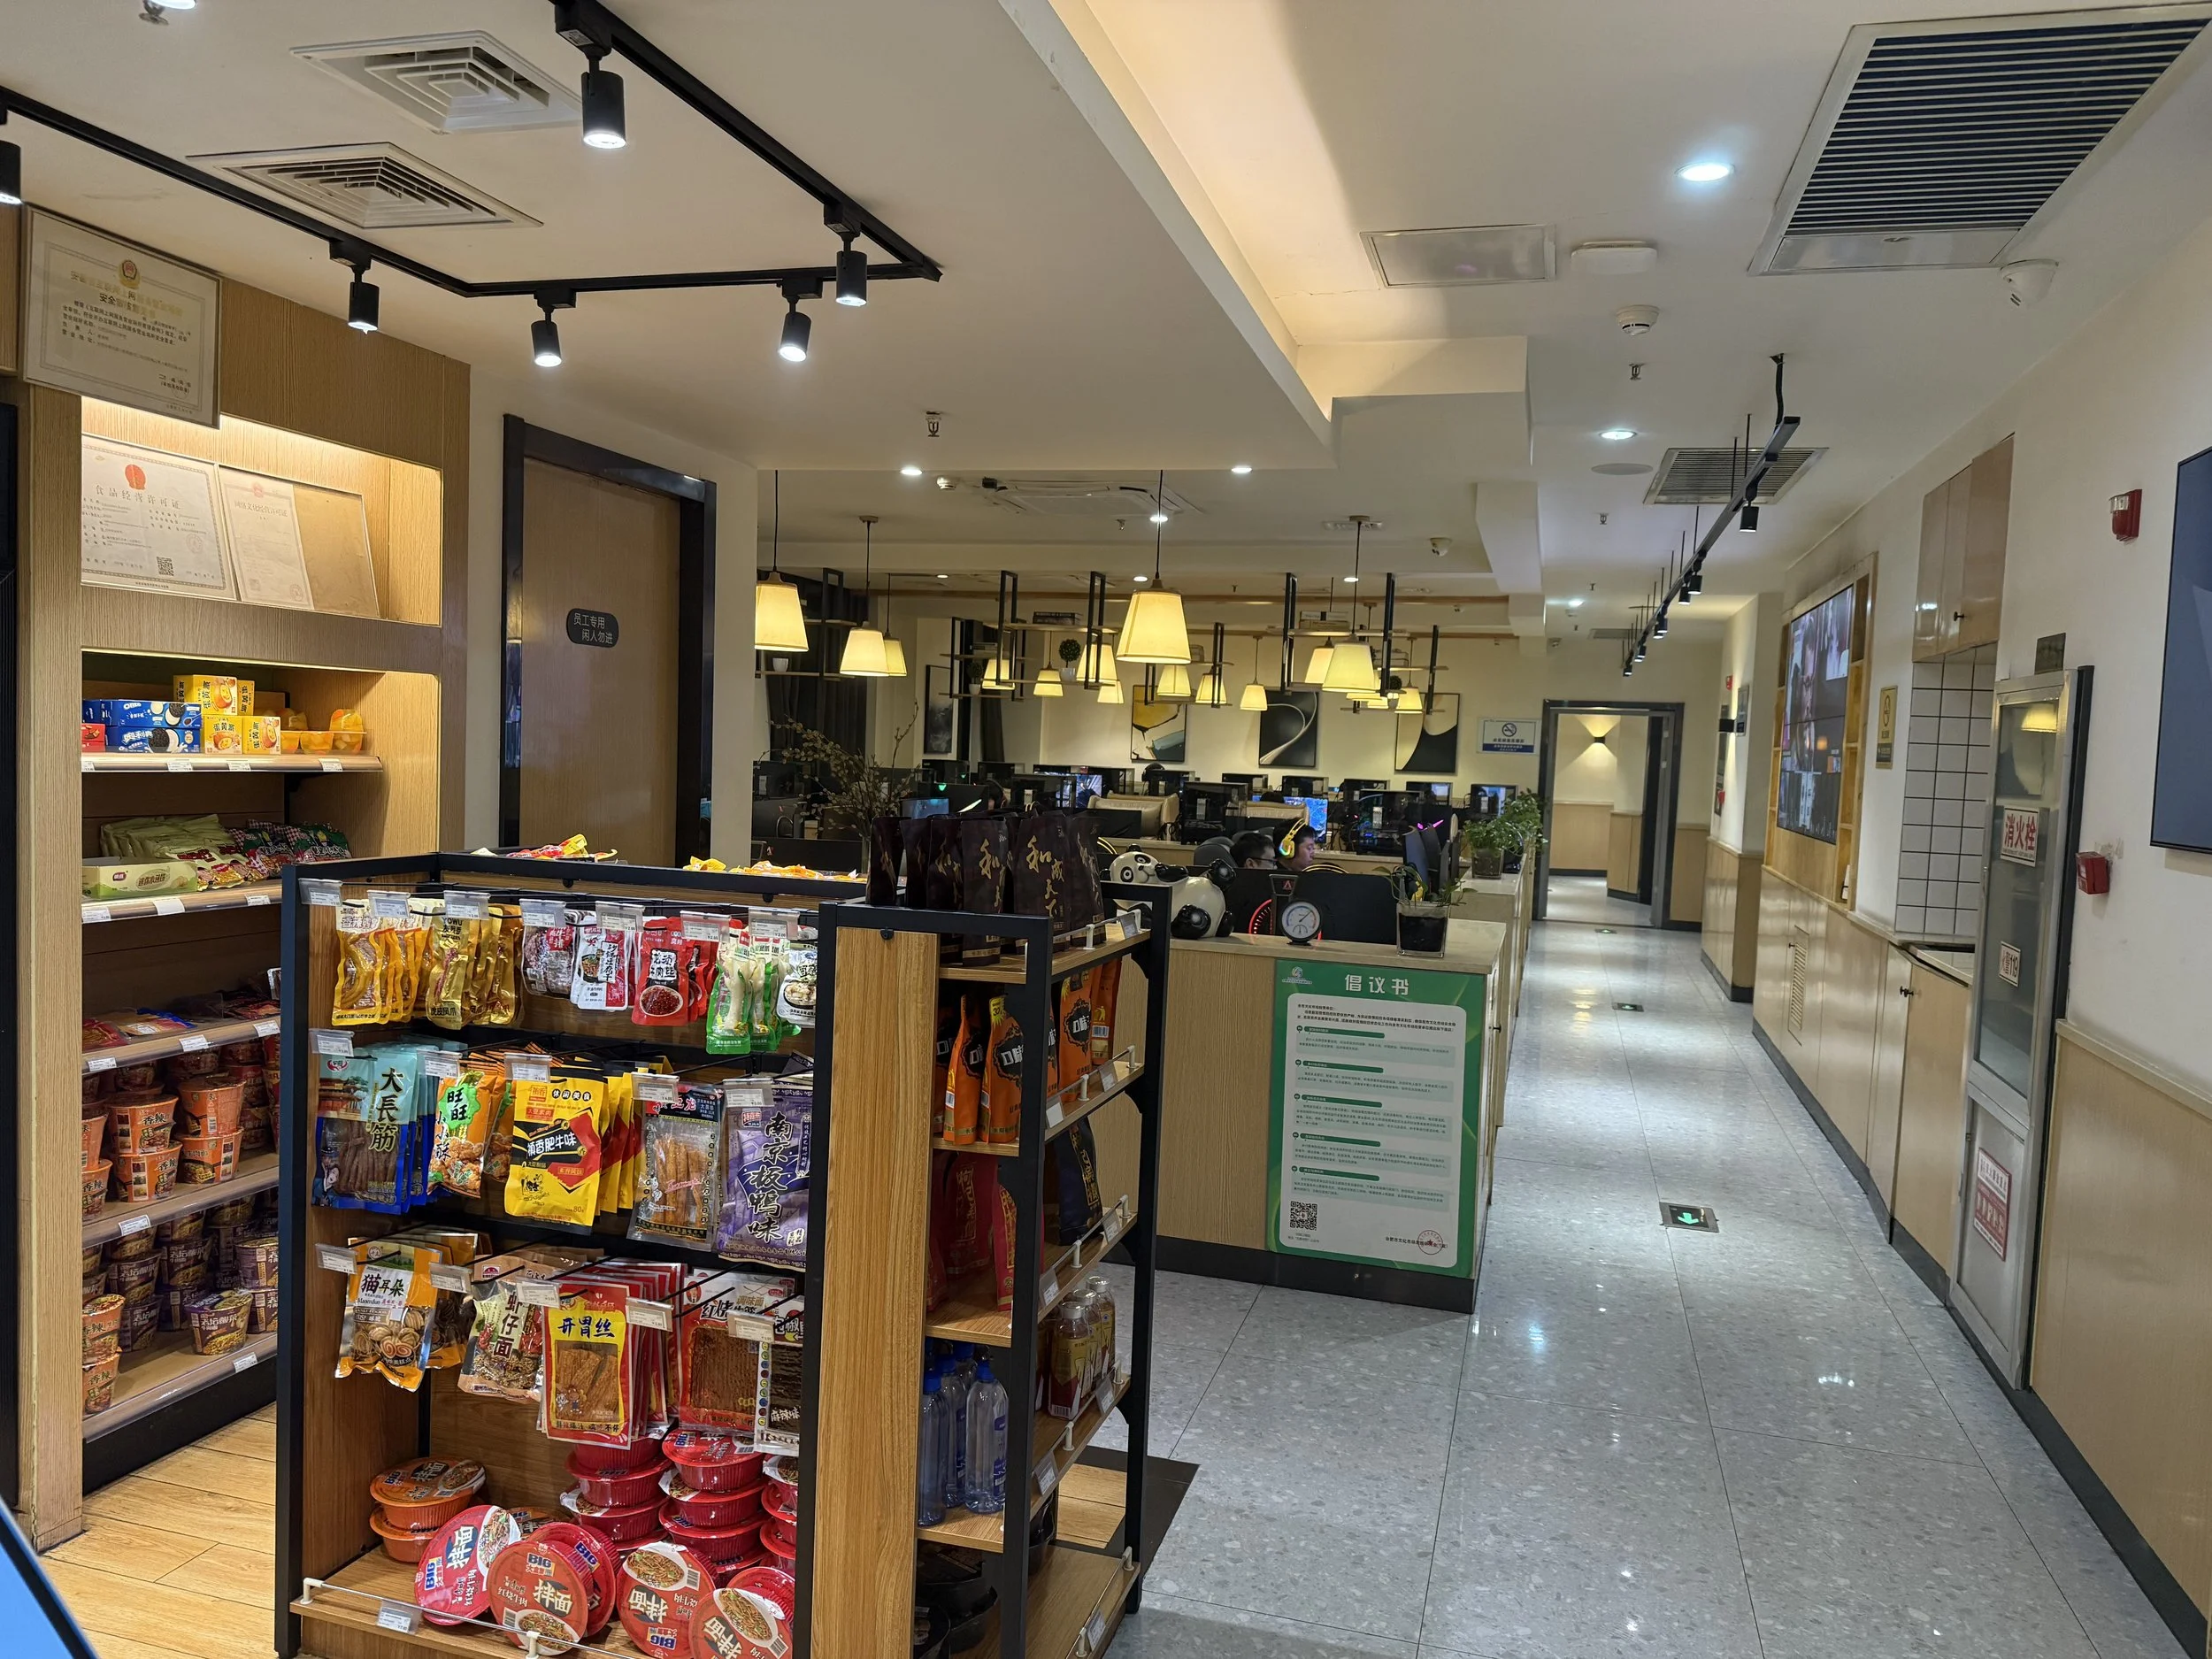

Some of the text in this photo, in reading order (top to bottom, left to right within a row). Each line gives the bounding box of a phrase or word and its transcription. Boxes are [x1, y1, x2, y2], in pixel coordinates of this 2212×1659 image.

[96, 485, 180, 510] 食品经营许可证
[574, 612, 605, 629] 员工专用
[581, 629, 613, 644] 闲人勿进
[2004, 813, 2036, 851] 消火栓
[1345, 974, 1409, 995] 倡议书
[448, 1087, 468, 1121] 旺旺
[552, 1088, 591, 1102] 休闲美食
[143, 1112, 166, 1125] 香辣
[368, 1067, 403, 1152] 大長筋
[157, 1157, 177, 1171] 香辣
[361, 1273, 404, 1298] 猫耳朵
[558, 1316, 615, 1339] 开胃丝
[88, 1371, 112, 1385] 香辣
[415, 1462, 448, 1482] 拌面
[447, 1526, 478, 1570] 拌面
[576, 1543, 598, 1564] BIG
[527, 1553, 552, 1569] BIG
[425, 1559, 436, 1590] BIG
[498, 1586, 529, 1607] 红烧牛肉
[533, 1579, 573, 1615] 拌面
[629, 1589, 669, 1624] 拌面
[650, 1635, 676, 1649] BIG
